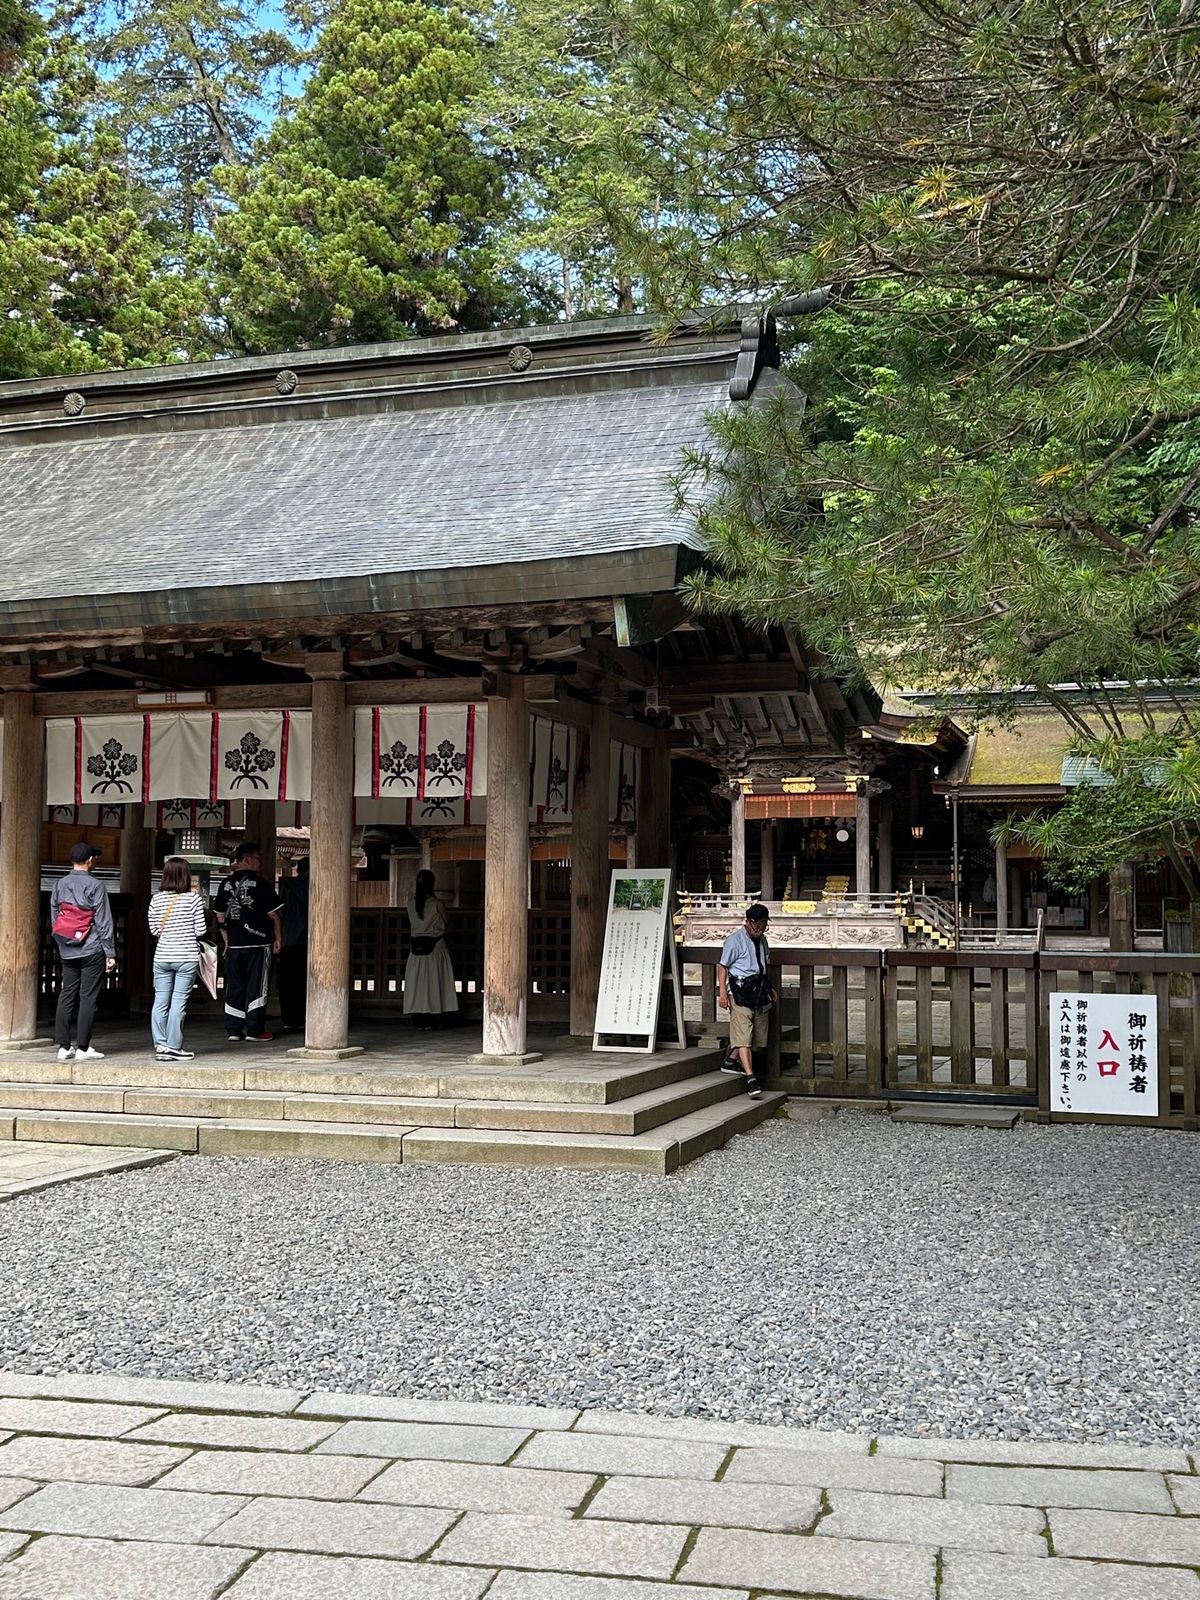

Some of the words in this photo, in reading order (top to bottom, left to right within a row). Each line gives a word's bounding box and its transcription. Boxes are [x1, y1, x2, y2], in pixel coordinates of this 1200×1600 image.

[1060, 999, 1071, 1109] 立入は御遠慮下さい。
[1076, 1000, 1087, 1081] 御祈祷者以外の
[1097, 1030, 1120, 1077] 入口
[1127, 1013, 1148, 1093] 御祈祷者
